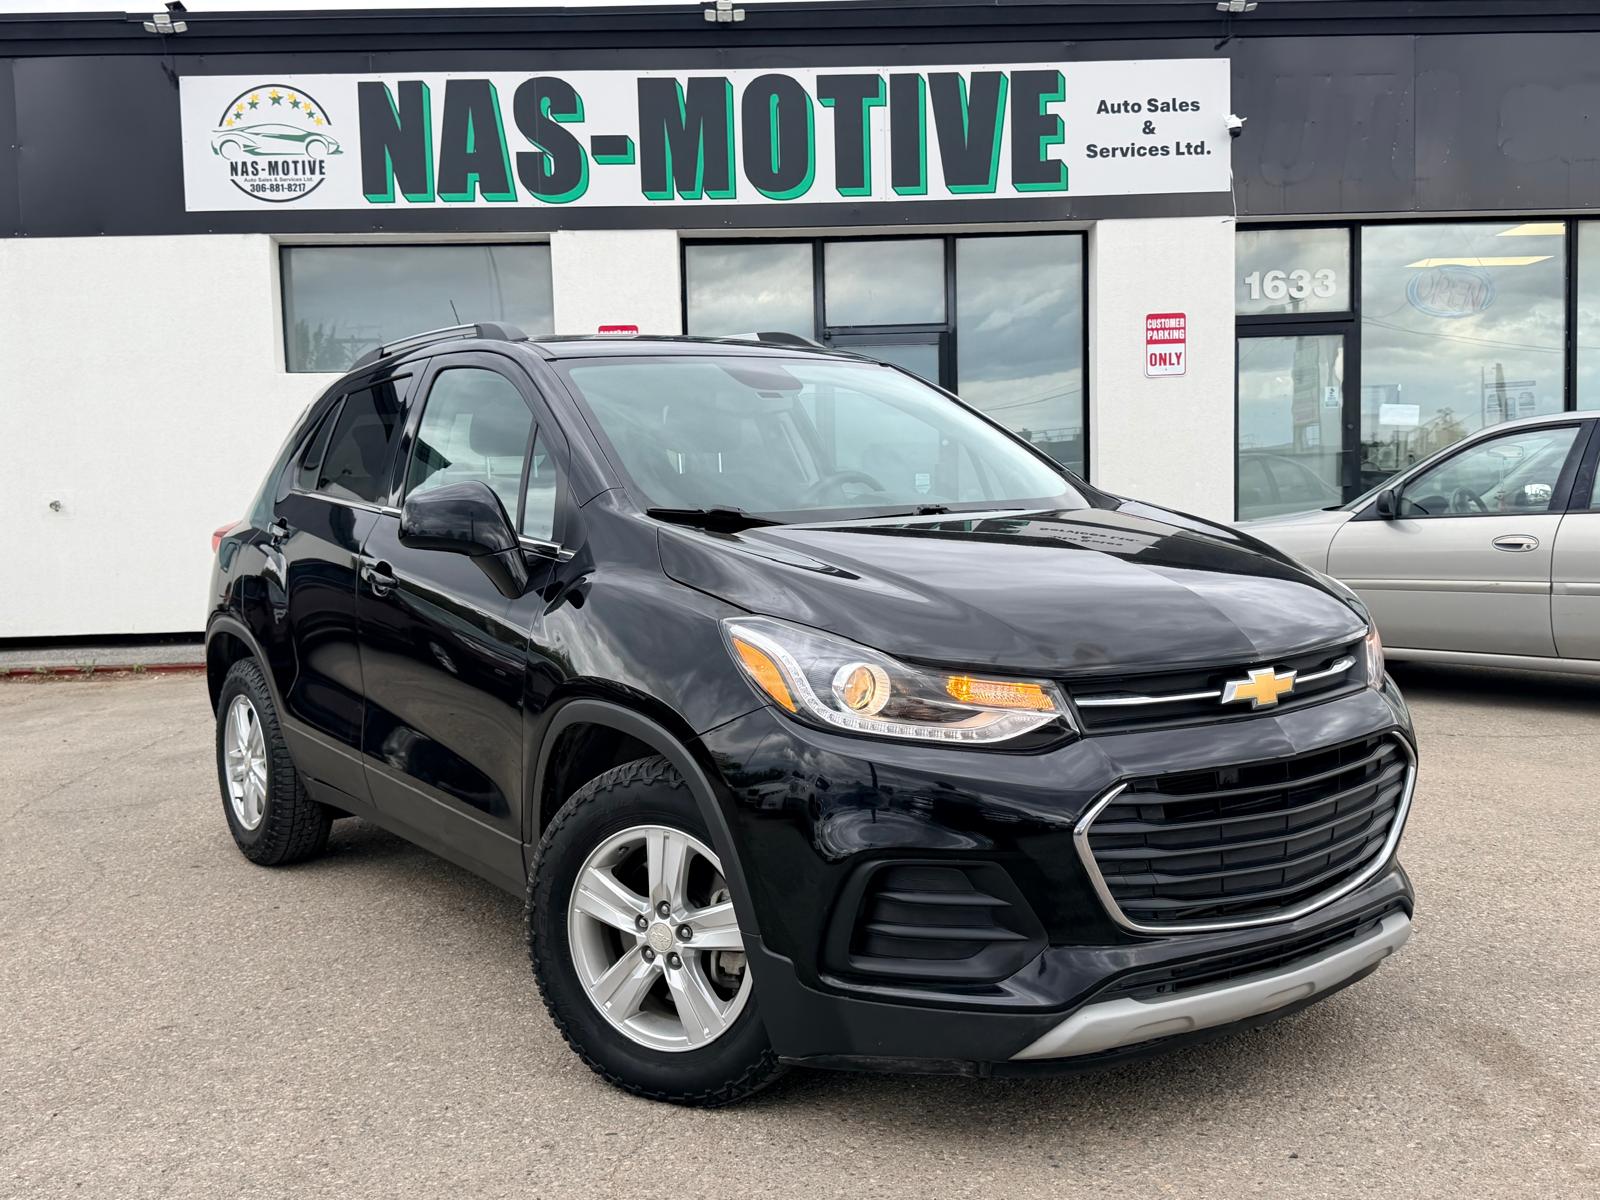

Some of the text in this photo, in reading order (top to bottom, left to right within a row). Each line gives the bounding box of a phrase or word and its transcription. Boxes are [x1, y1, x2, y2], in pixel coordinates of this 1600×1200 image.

[1096, 98, 1200, 114] Auto Sales
[1142, 120, 1156, 135] &
[357, 70, 1069, 204] NAS-MOTIVE
[1086, 140, 1211, 158] Services Ltd.
[230, 160, 326, 176] NAS-MOTIVE
[250, 183, 306, 193] 306-881-8217
[1243, 268, 1337, 300] 1633
[1147, 318, 1185, 329] CUSTOMER
[1147, 329, 1185, 340] PARKING
[1149, 352, 1182, 367] ONLY
